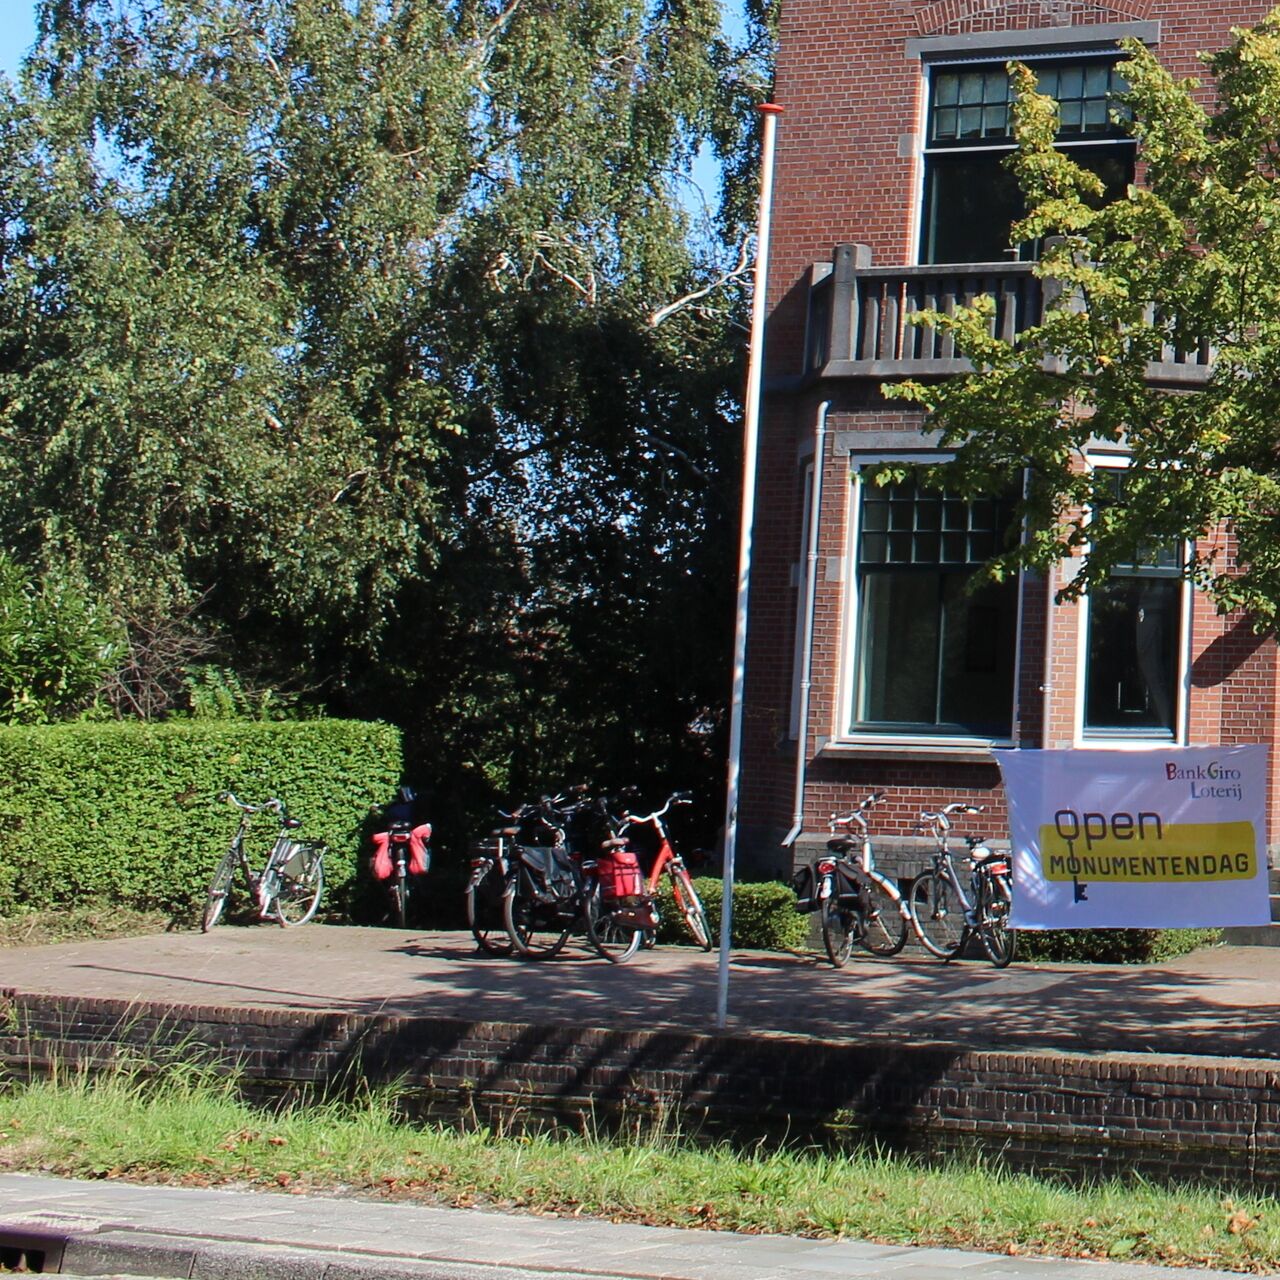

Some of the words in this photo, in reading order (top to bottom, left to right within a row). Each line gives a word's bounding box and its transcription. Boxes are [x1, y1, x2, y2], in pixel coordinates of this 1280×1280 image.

[1165, 761, 1241, 780] BankGiro
[1190, 781, 1243, 801] Loterij
[1049, 852, 1250, 876] MONUMENTENDAG
